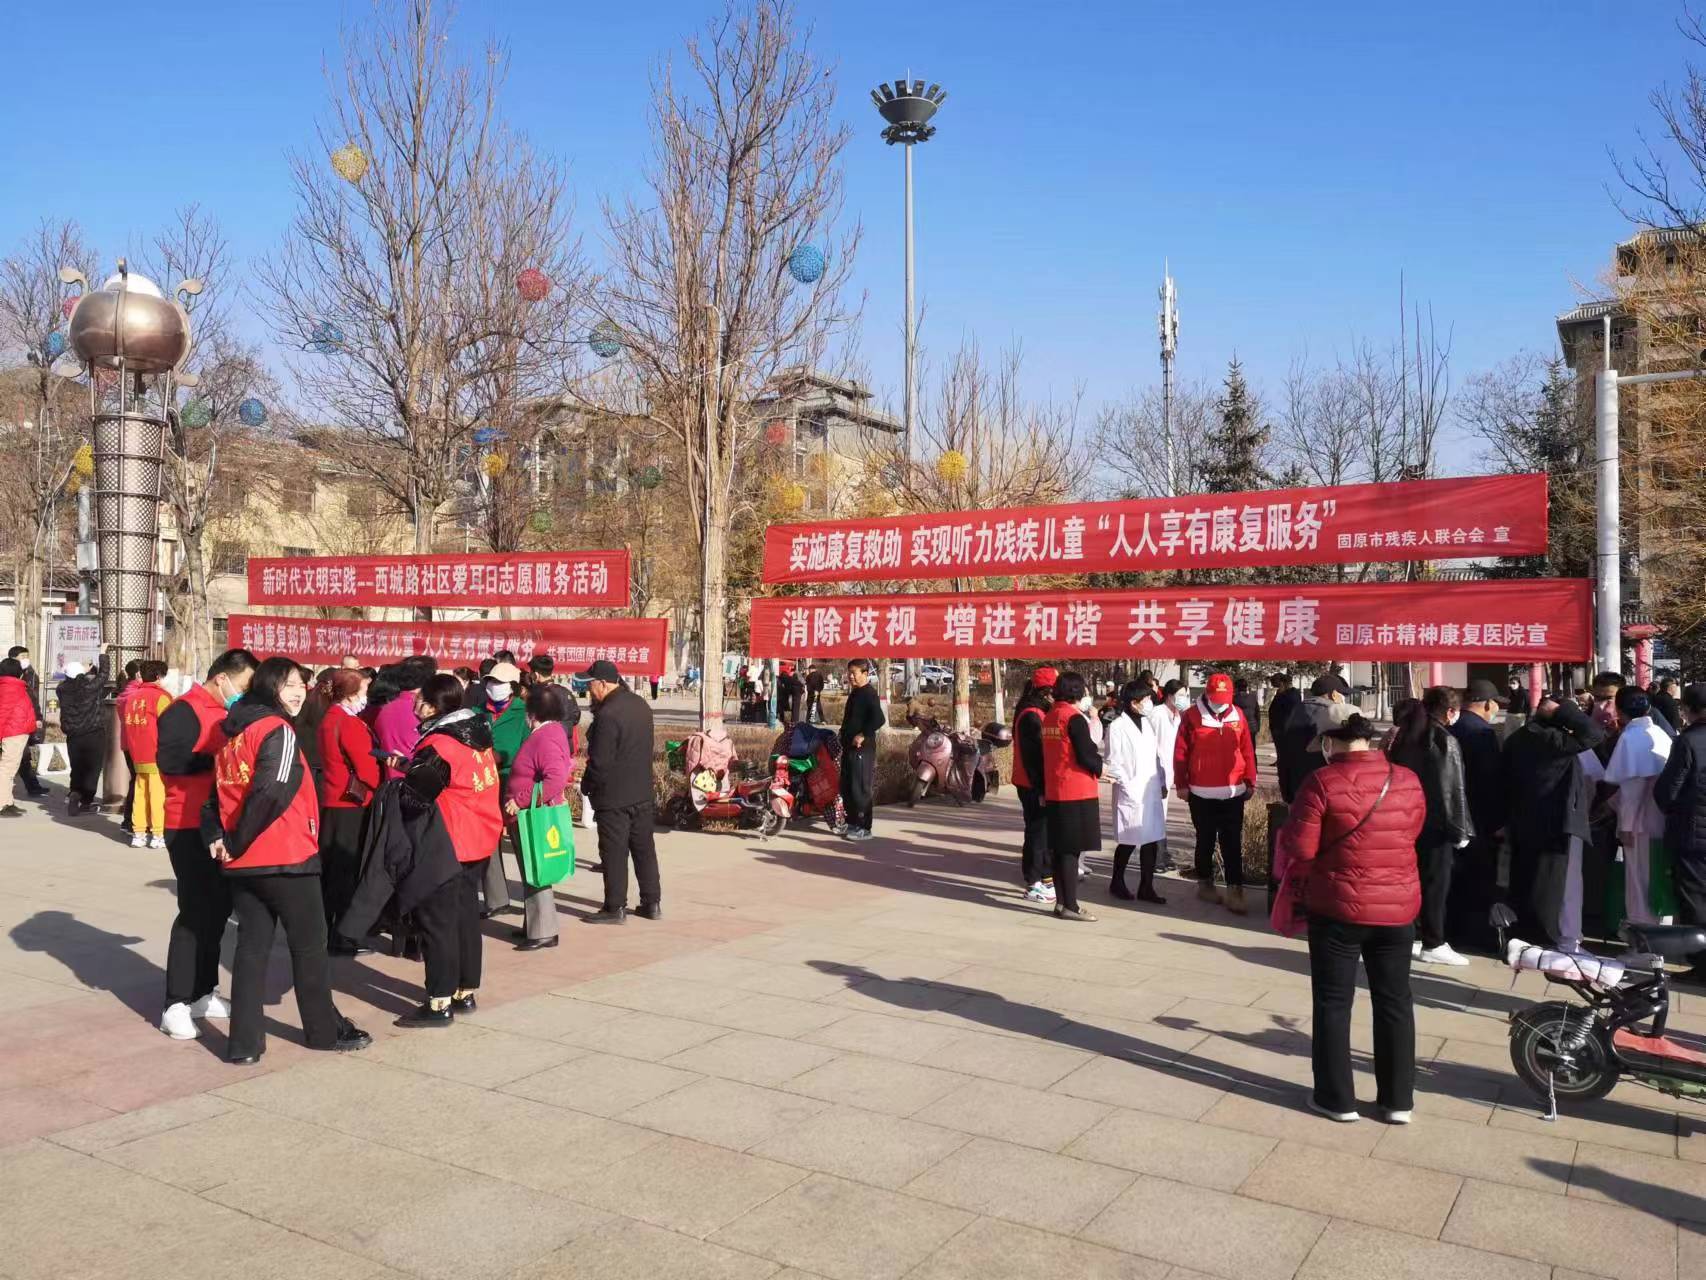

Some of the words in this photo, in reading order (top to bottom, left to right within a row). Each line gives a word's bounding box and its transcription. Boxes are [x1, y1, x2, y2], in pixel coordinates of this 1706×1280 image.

[788, 527, 902, 572] 实施康复救助
[911, 515, 1086, 567] 实现听力残疾儿童
[1337, 527, 1485, 550] 固原市残疾人联合会
[1493, 526, 1511, 543] 宣
[242, 623, 312, 654] 实施康复救助
[781, 605, 917, 648] 消除歧视
[943, 600, 1102, 647] 增进和谐
[1128, 596, 1321, 647] 共享健康
[1336, 623, 1548, 647] 固原市精神康复医院宣
